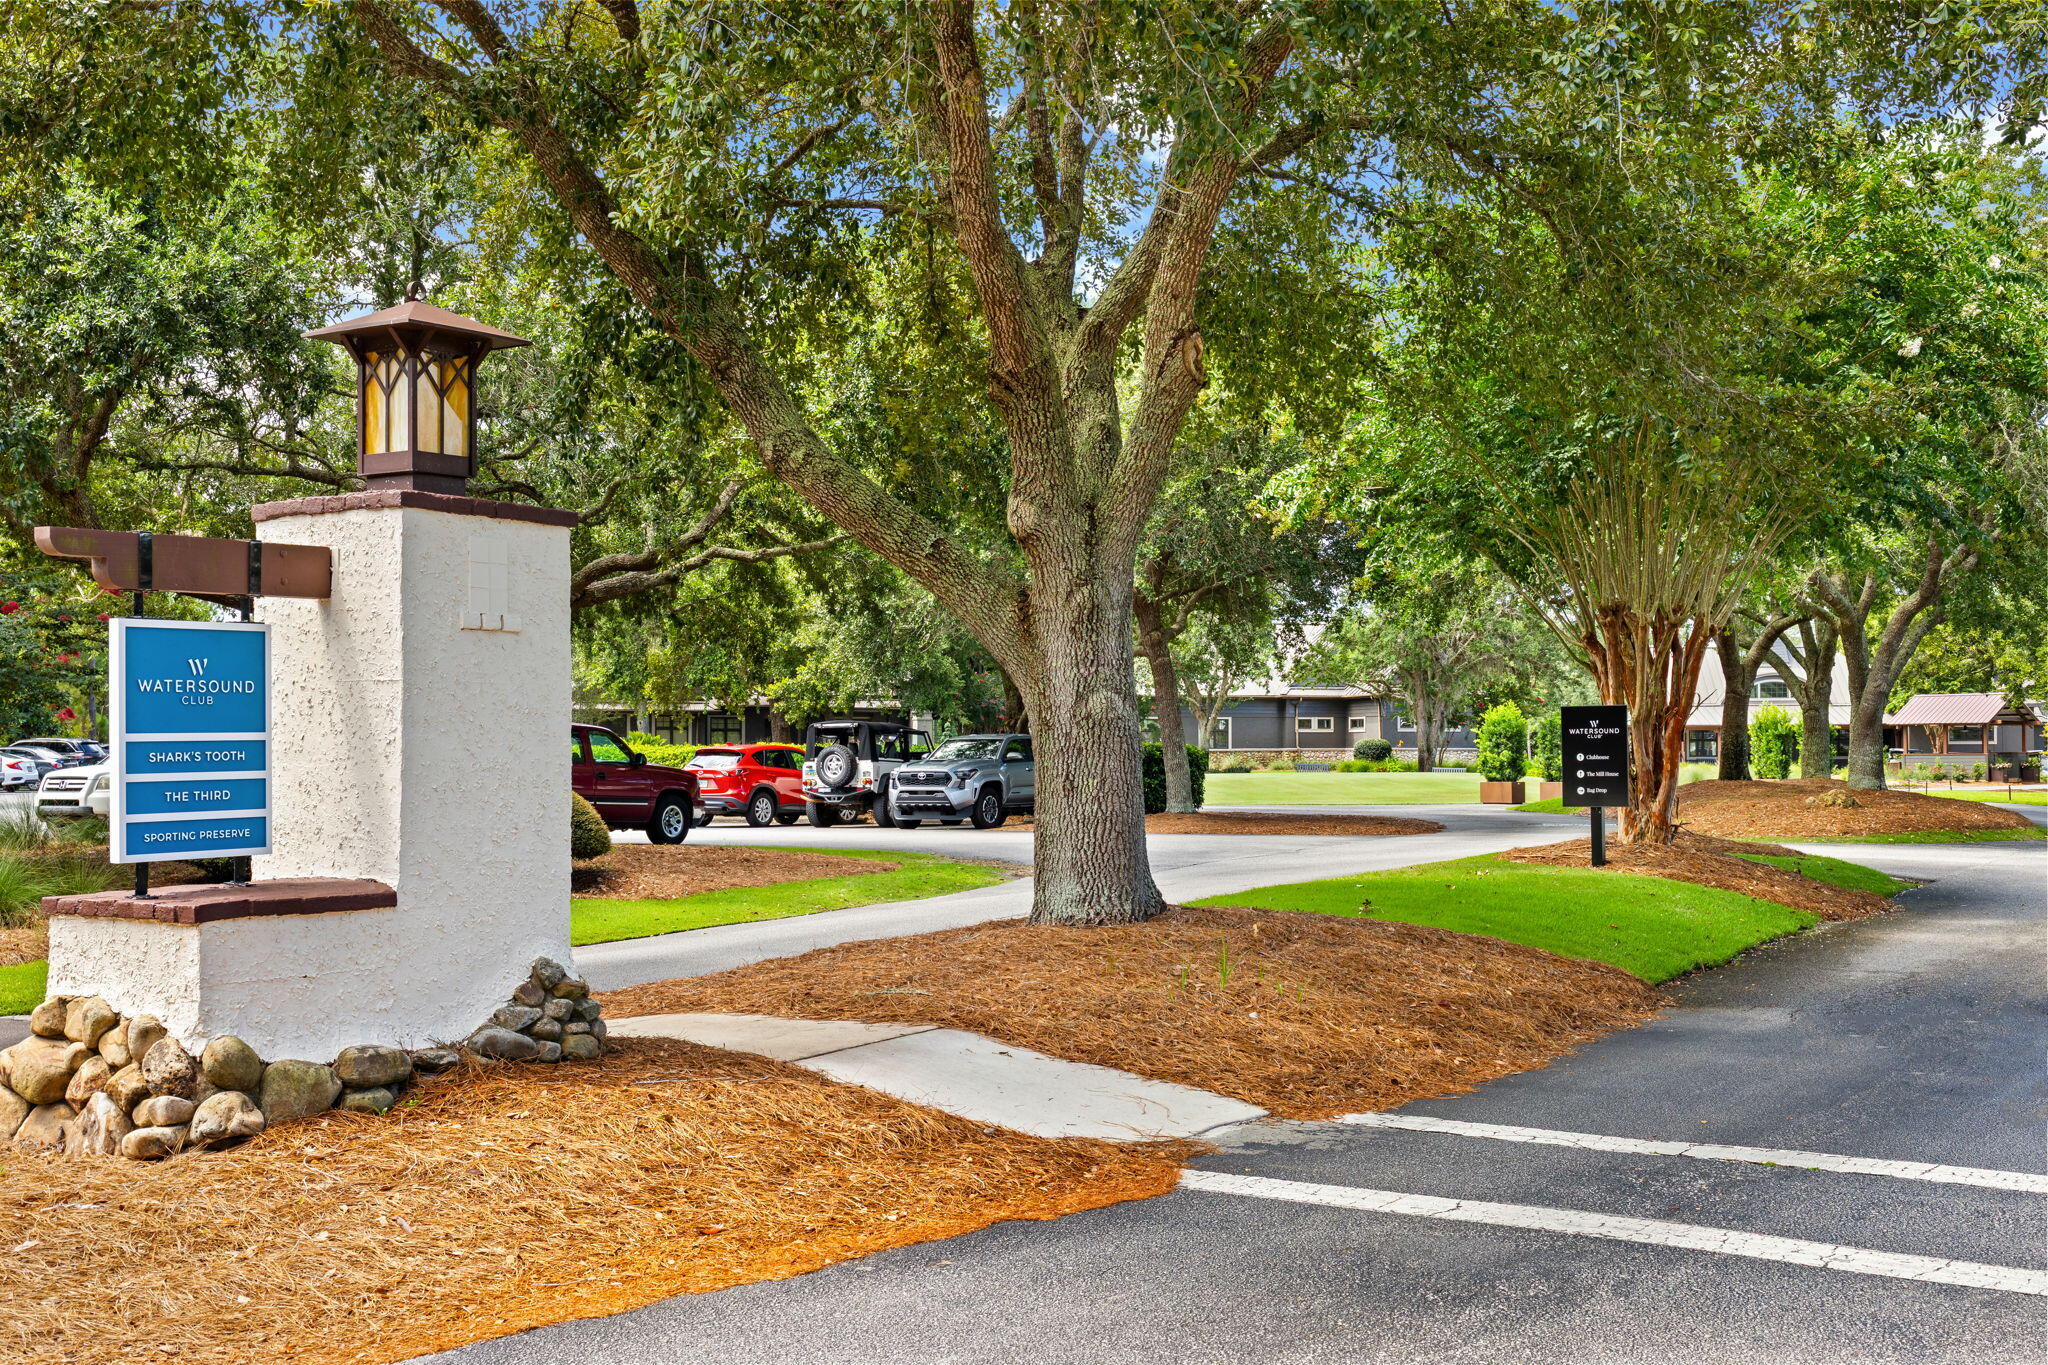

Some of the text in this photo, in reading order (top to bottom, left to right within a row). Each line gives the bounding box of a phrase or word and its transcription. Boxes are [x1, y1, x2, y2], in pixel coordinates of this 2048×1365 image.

[138, 679, 255, 693] WATERSOUND
[181, 696, 214, 705] CLUB
[149, 751, 246, 763] SHARK'S TOOTH
[165, 790, 231, 802] THE THIRD
[144, 829, 251, 843] SPORTING PRESERVE
